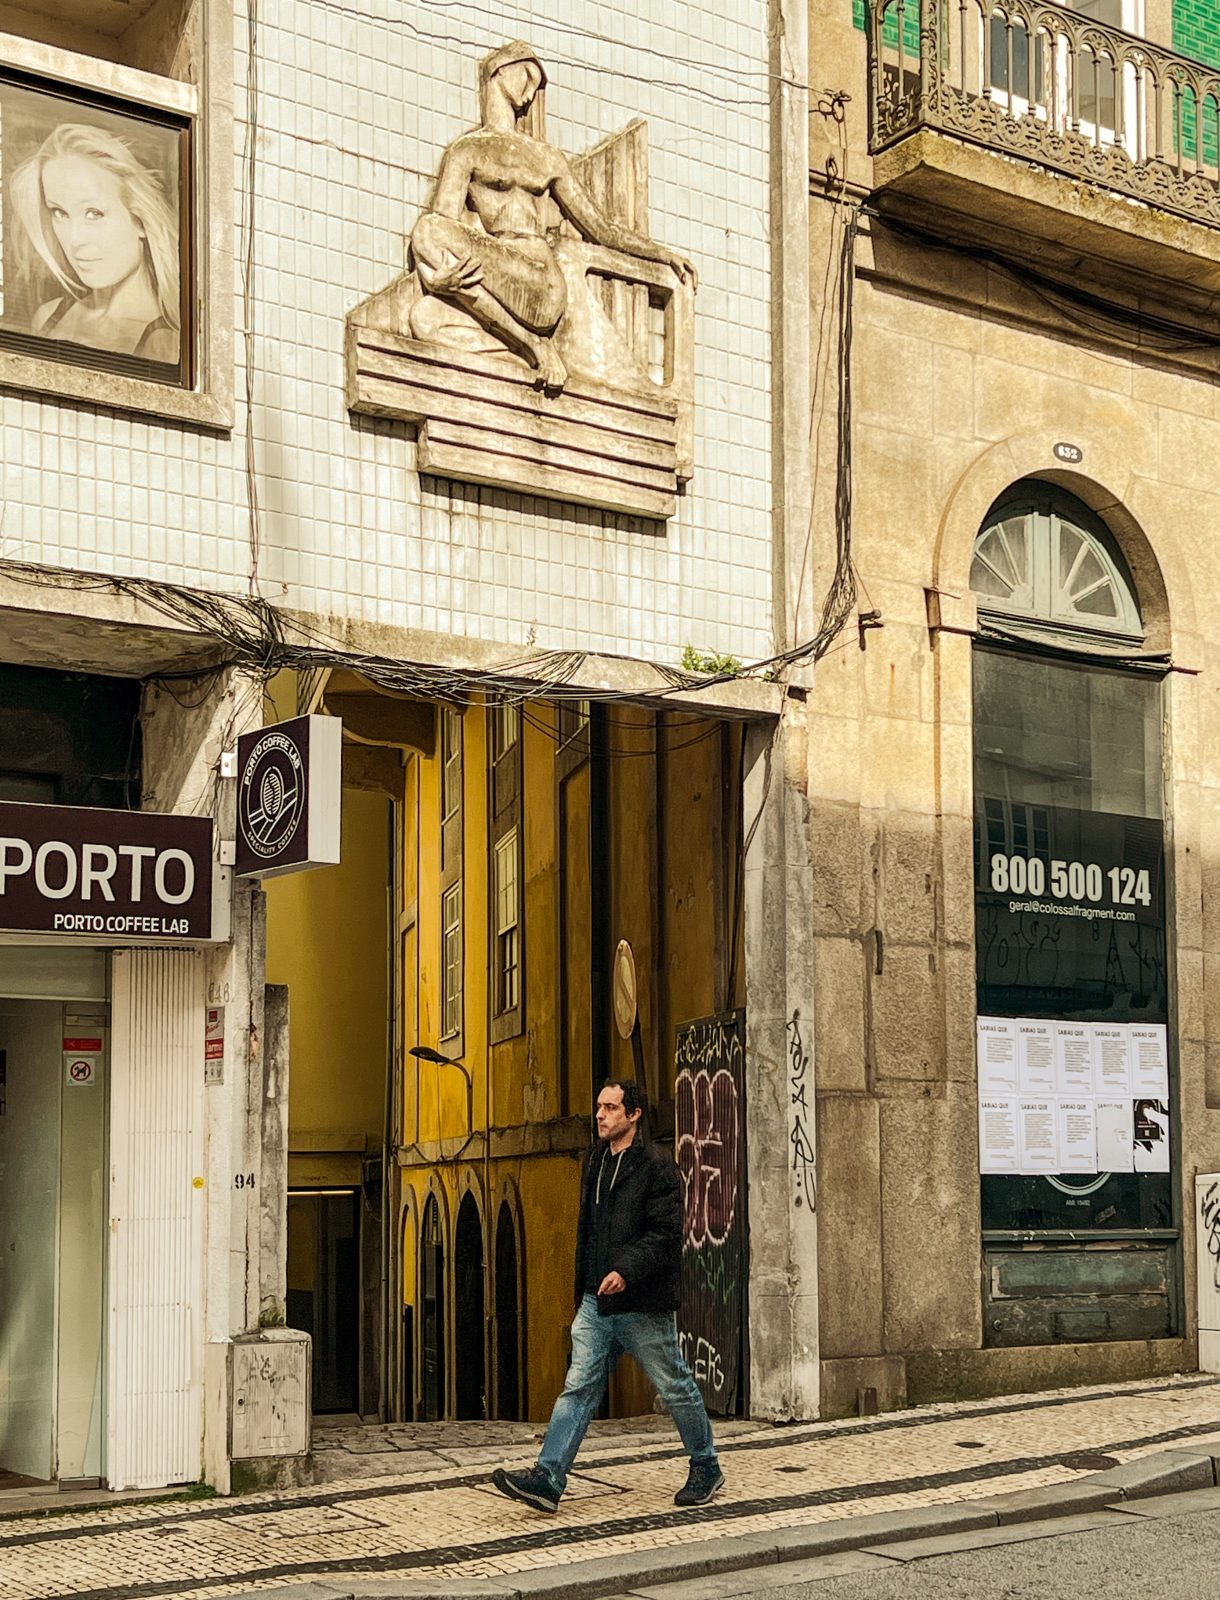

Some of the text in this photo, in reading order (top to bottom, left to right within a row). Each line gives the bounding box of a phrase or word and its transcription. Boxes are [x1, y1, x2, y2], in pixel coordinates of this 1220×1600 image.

[243, 735, 301, 786] PORTO COFFEE LAB
[247, 820, 297, 854] SPECIALITY COFFEE
[0, 837, 195, 905] PORTO
[991, 853, 1152, 907] 800 500 124
[54, 913, 189, 934] PORTO COFFEE LAB
[1009, 900, 1136, 921] geral@colossalfragment.com
[234, 1173, 256, 1189] 94
